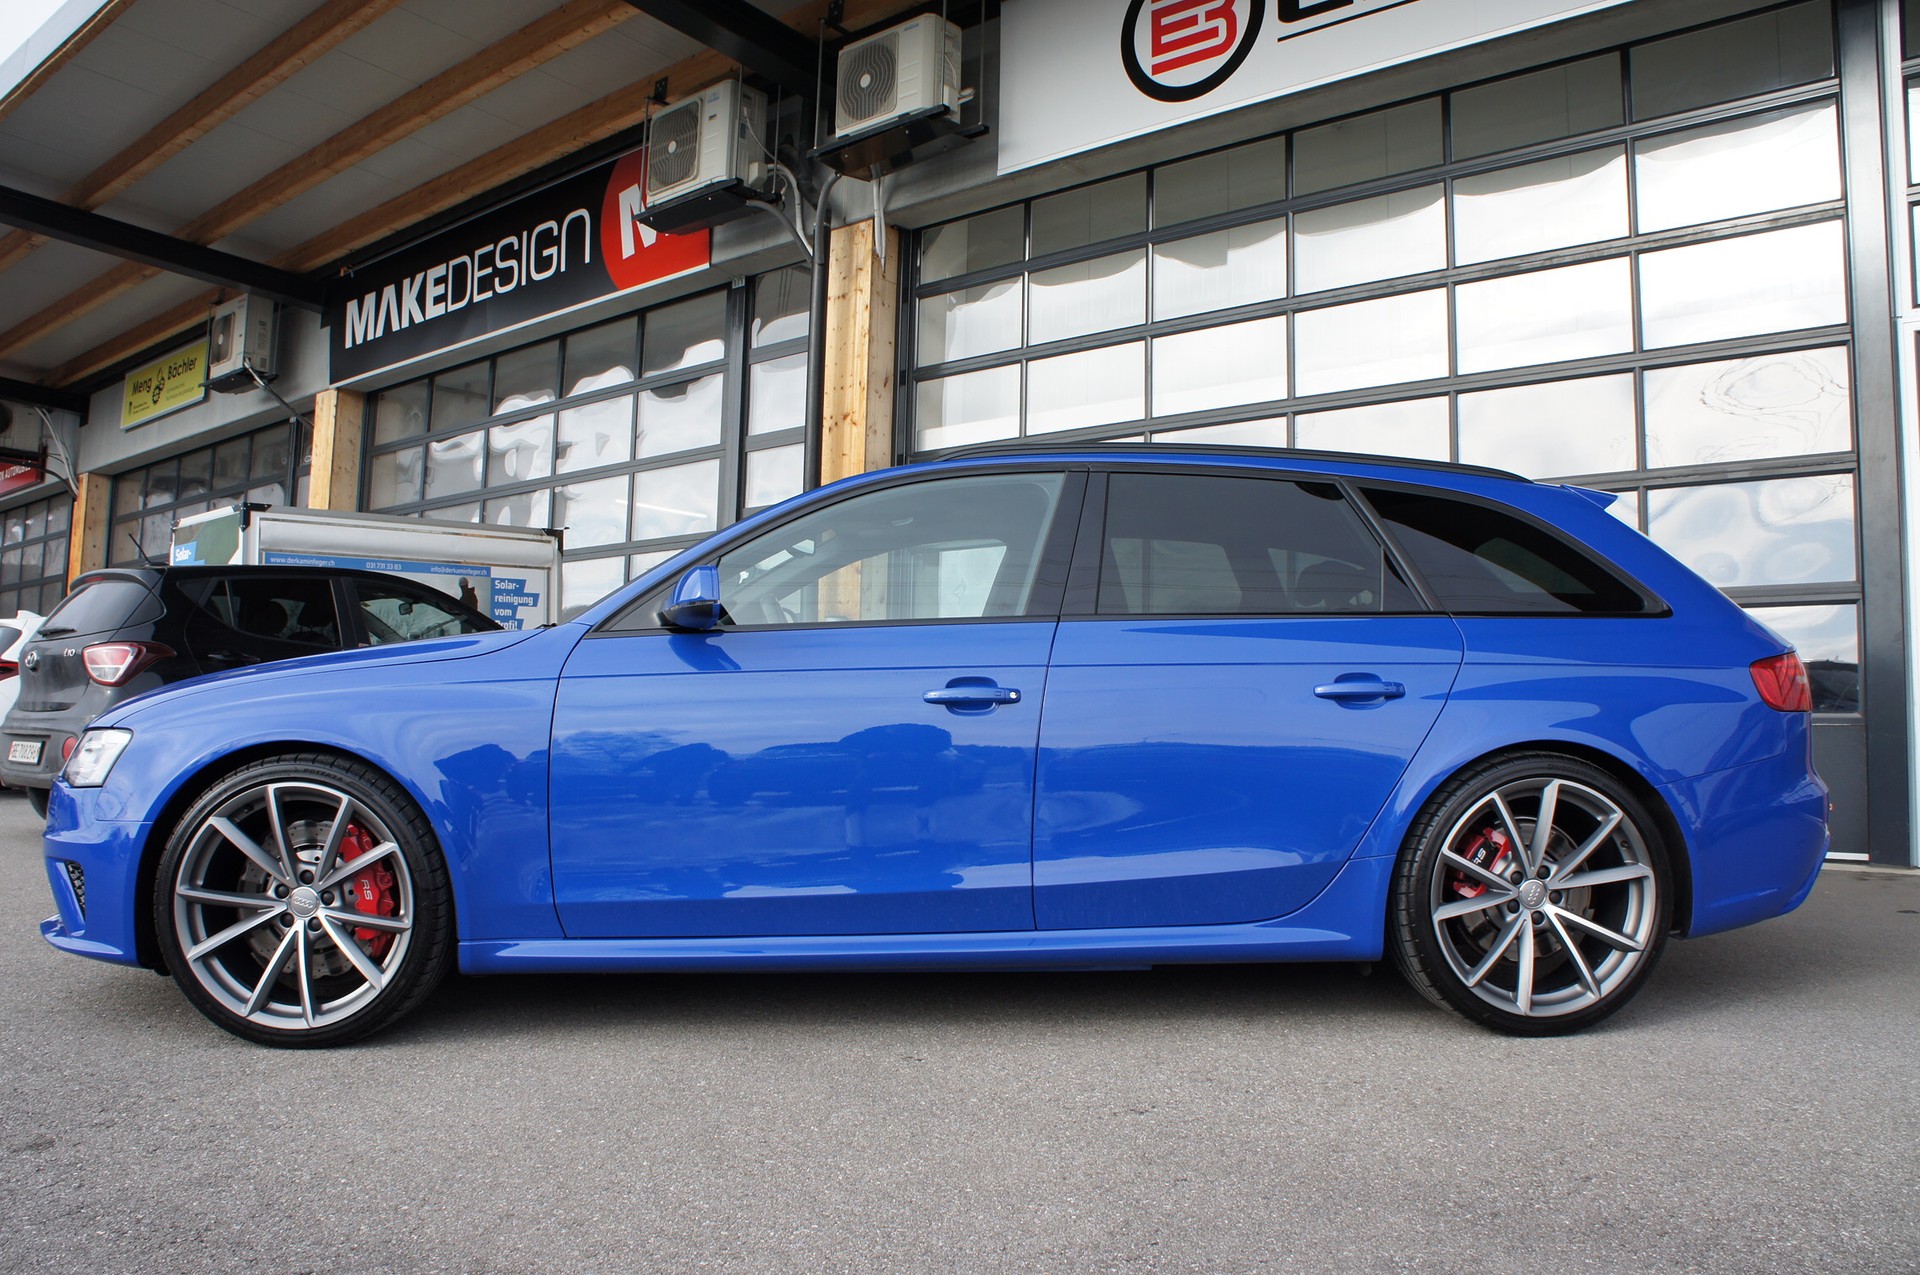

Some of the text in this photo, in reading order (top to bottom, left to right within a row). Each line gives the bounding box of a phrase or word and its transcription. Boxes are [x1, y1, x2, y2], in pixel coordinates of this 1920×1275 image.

[132, 378, 153, 396] Meng
[167, 357, 198, 380] Bächler
[495, 580, 520, 590] Solar-
[494, 593, 534, 606] reinigung
[494, 608, 512, 616] vom
[361, 879, 373, 900] RS
